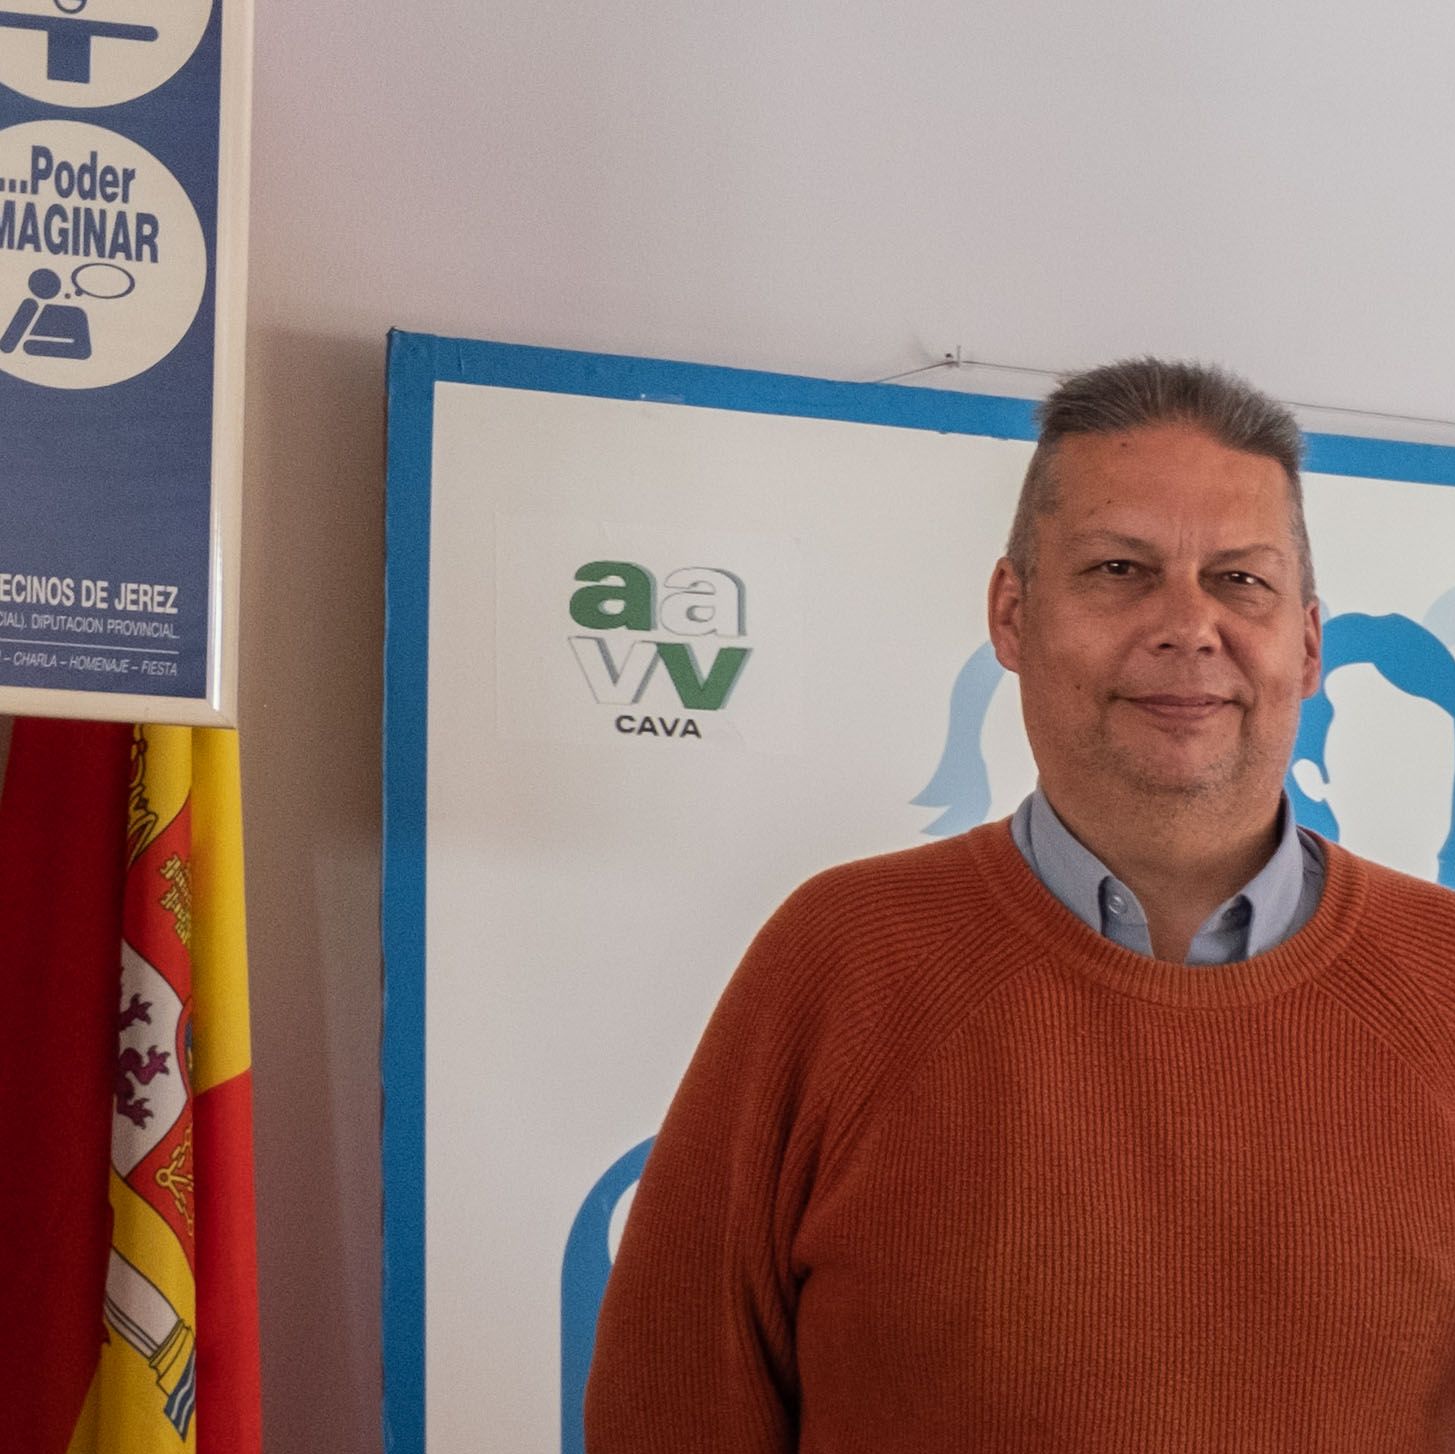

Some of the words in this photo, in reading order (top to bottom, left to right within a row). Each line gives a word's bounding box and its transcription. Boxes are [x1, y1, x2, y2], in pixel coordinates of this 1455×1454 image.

[81, 579, 109, 609] DE
[115, 582, 179, 614] JEREZ
[13, 651, 57, 667] CHARLA
[69, 656, 130, 673] HOMENAJE
[614, 714, 702, 738] CAVA
